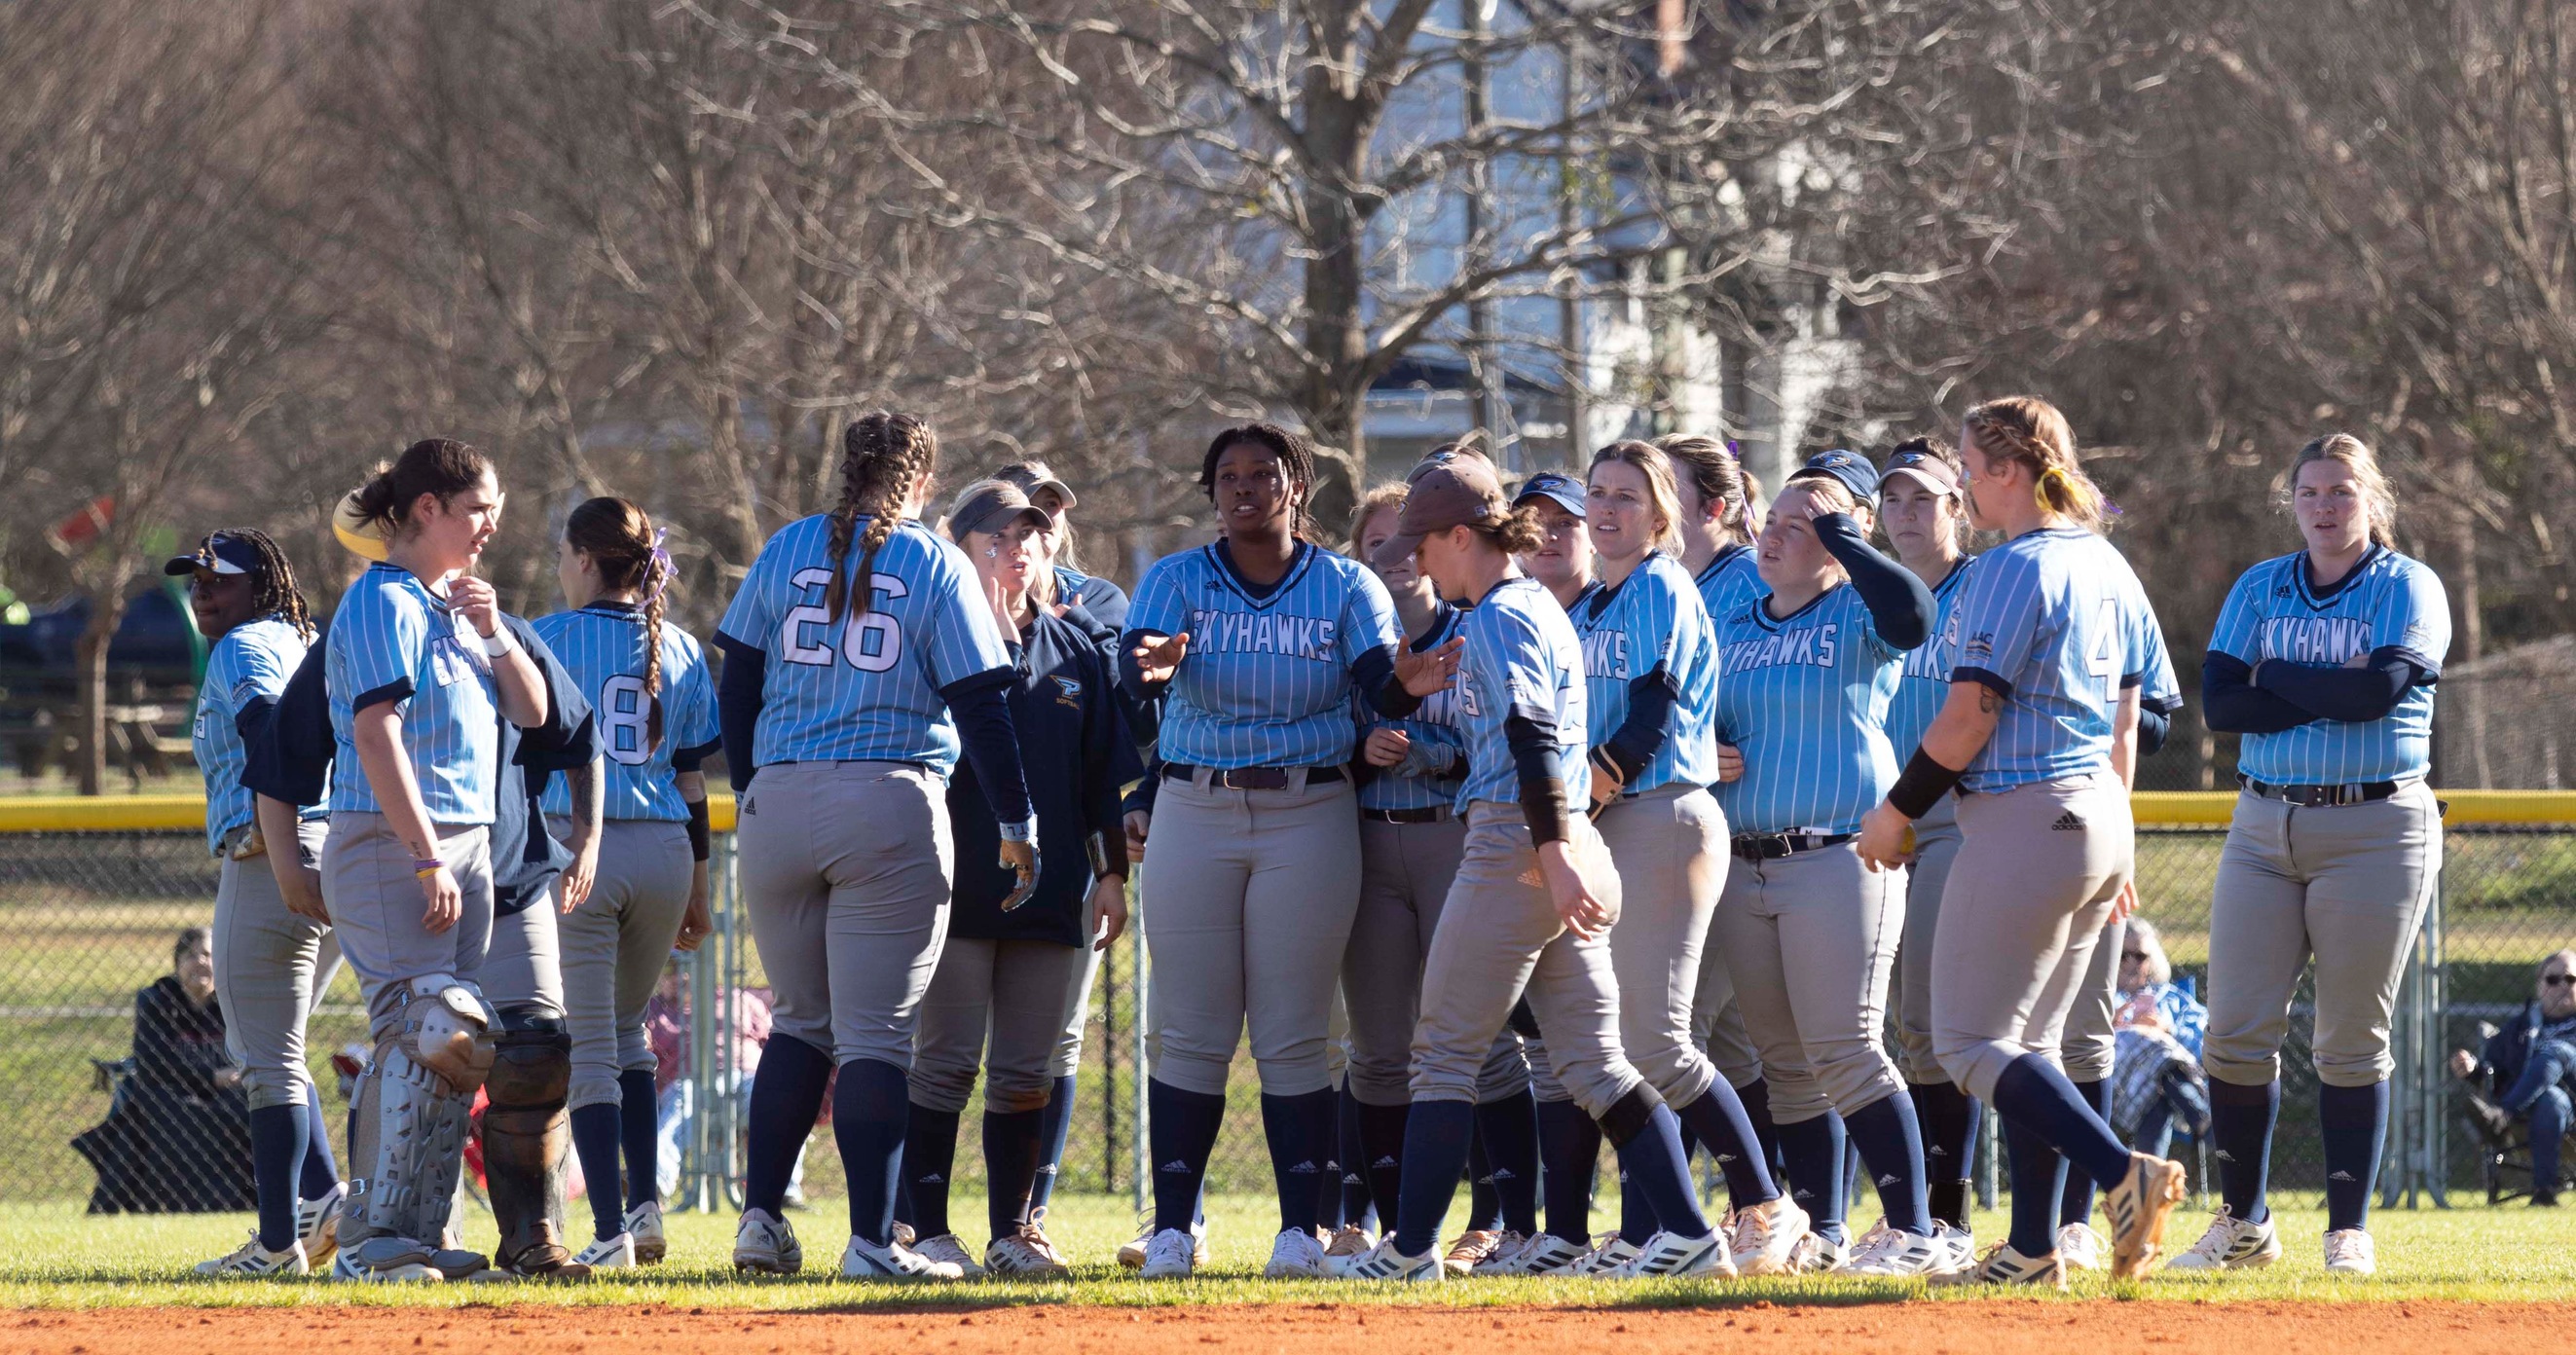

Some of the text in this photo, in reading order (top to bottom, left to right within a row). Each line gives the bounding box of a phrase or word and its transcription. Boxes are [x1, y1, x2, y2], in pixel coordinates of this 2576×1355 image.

[782, 566, 909, 674] 26
[1186, 608, 1336, 664] SKYHAWKS
[2083, 598, 2122, 703] 4
[601, 674, 652, 766] 8
[2051, 823, 2086, 831] adidas
